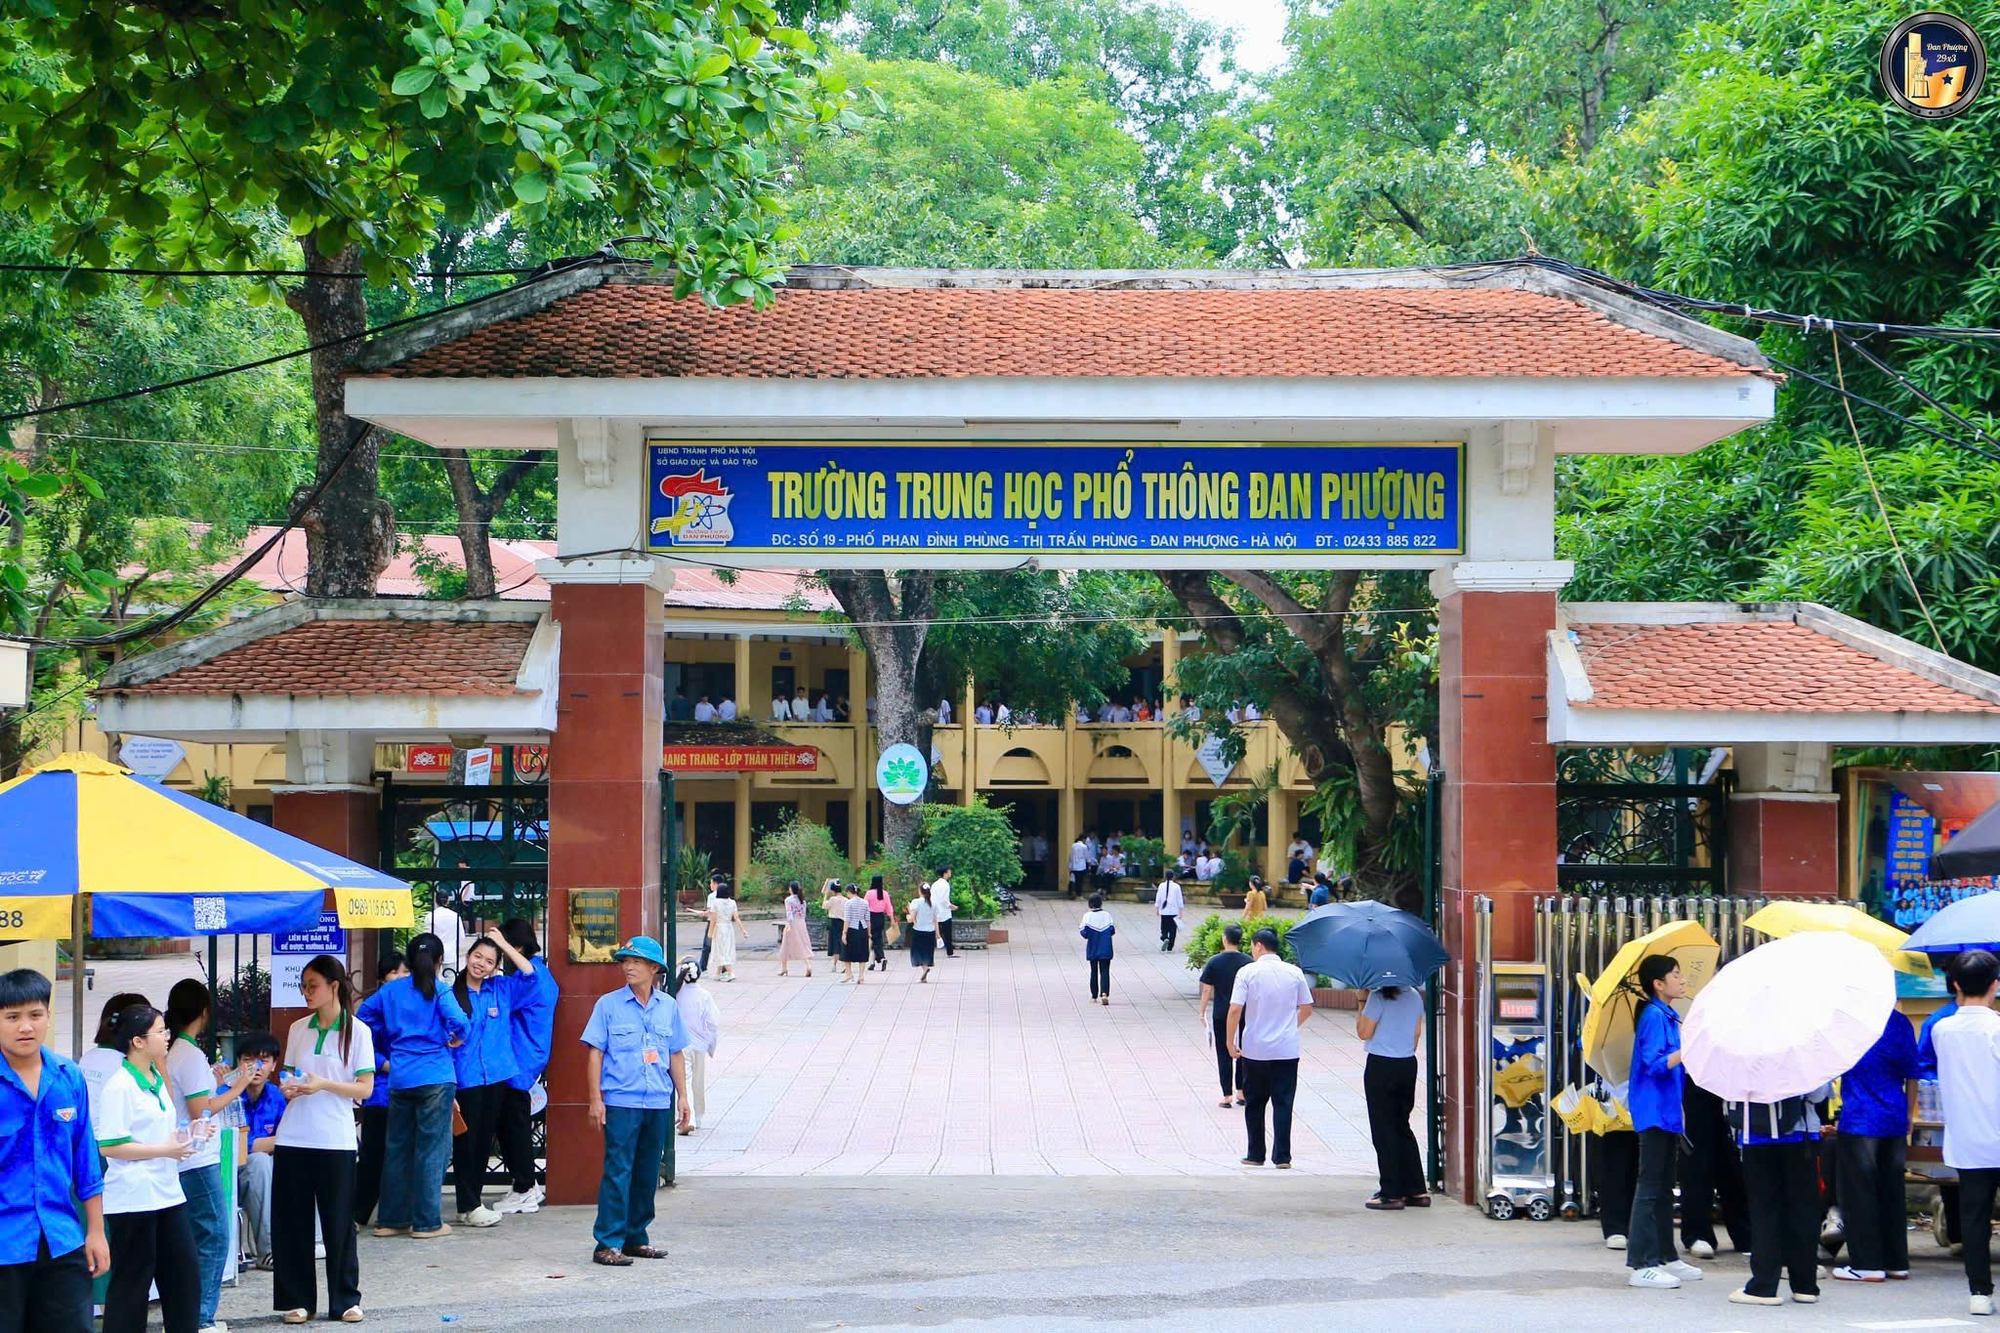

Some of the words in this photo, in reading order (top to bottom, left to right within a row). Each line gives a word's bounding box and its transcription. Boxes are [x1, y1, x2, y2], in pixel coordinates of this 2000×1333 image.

[709, 457, 720, 466] VÀ
[742, 458, 758, 467] TẠO
[767, 461, 886, 519] TRƯỜNG
[895, 471, 993, 519] TRUNG
[1003, 471, 1063, 529] HỌC
[1073, 449, 1133, 520] PHỔ
[1141, 461, 1239, 520] THÔNG
[1248, 472, 1312, 520] ĐAN
[1321, 467, 1445, 530] PHƯỢNG
[771, 534, 797, 546] ĐC:
[799, 529, 818, 546] SỐ
[823, 534, 836, 546] 19
[846, 529, 875, 546] PHỐ
[882, 534, 919, 547] PHAN
[926, 530, 958, 547] ĐÌNH
[964, 531, 1009, 547] PHÙNG
[1022, 534, 1043, 549] THỊ
[1048, 530, 1087, 547] TRẤN
[1092, 531, 1138, 547] PHÙNG
[1150, 535, 1179, 547] ĐAN
[1183, 534, 1239, 550] PHƯỢNG
[1251, 532, 1270, 547] HÀ
[1274, 532, 1297, 550] NỘI
[1315, 535, 1339, 547] ĐT:
[1343, 535, 1381, 547] 02433
[1386, 535, 1409, 547] 885
[1413, 535, 1436, 547] 822
[663, 754, 687, 765] HANG
[689, 754, 720, 765] TRANG
[725, 750, 742, 765] LỚP
